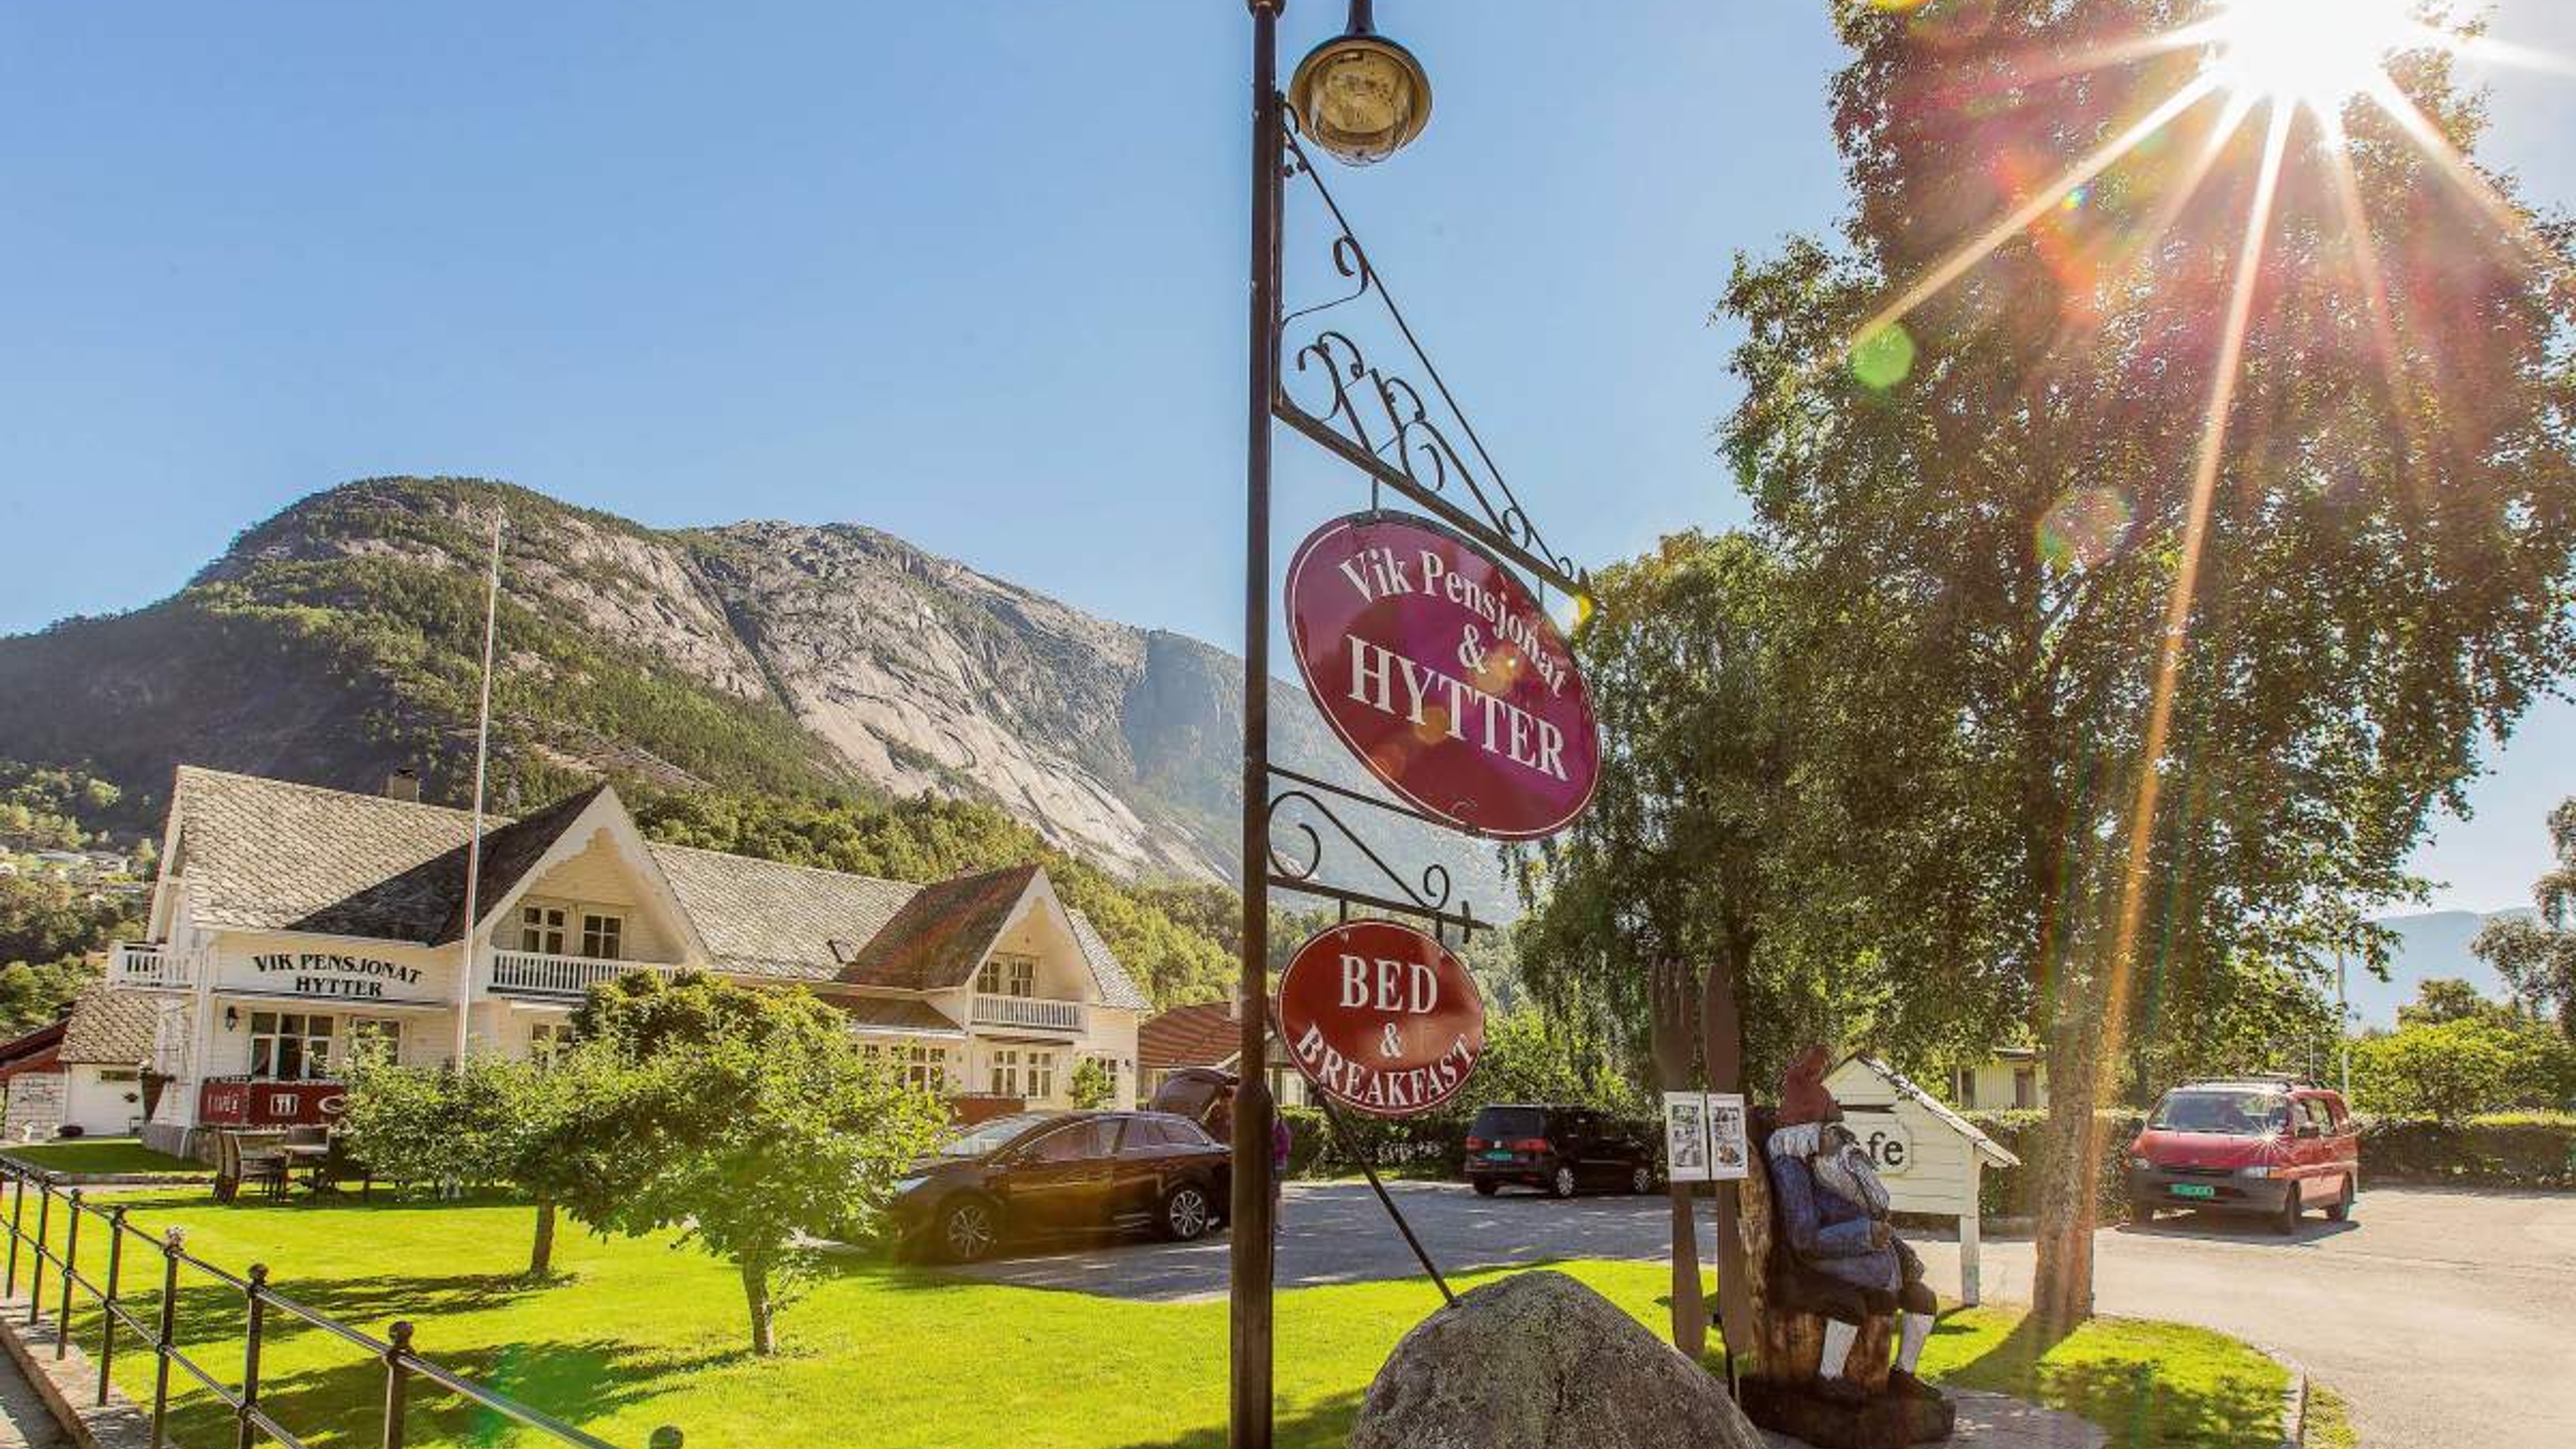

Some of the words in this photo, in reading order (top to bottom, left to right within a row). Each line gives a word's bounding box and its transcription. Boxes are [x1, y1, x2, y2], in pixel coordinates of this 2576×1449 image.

[1340, 547, 1413, 603] Vik
[1420, 550, 1566, 698] Pensjonat
[1458, 623, 1487, 675] &
[1346, 634, 1568, 782] HYTTER
[254, 953, 294, 972] VIK
[300, 954, 422, 984] PENSJONAT
[295, 977, 382, 997] HYTTER
[1340, 954, 1438, 1014] BED
[1297, 1022, 1473, 1106] BREAKFAST
[1381, 1022, 1402, 1058] &
[1867, 1131, 1903, 1165] fe
